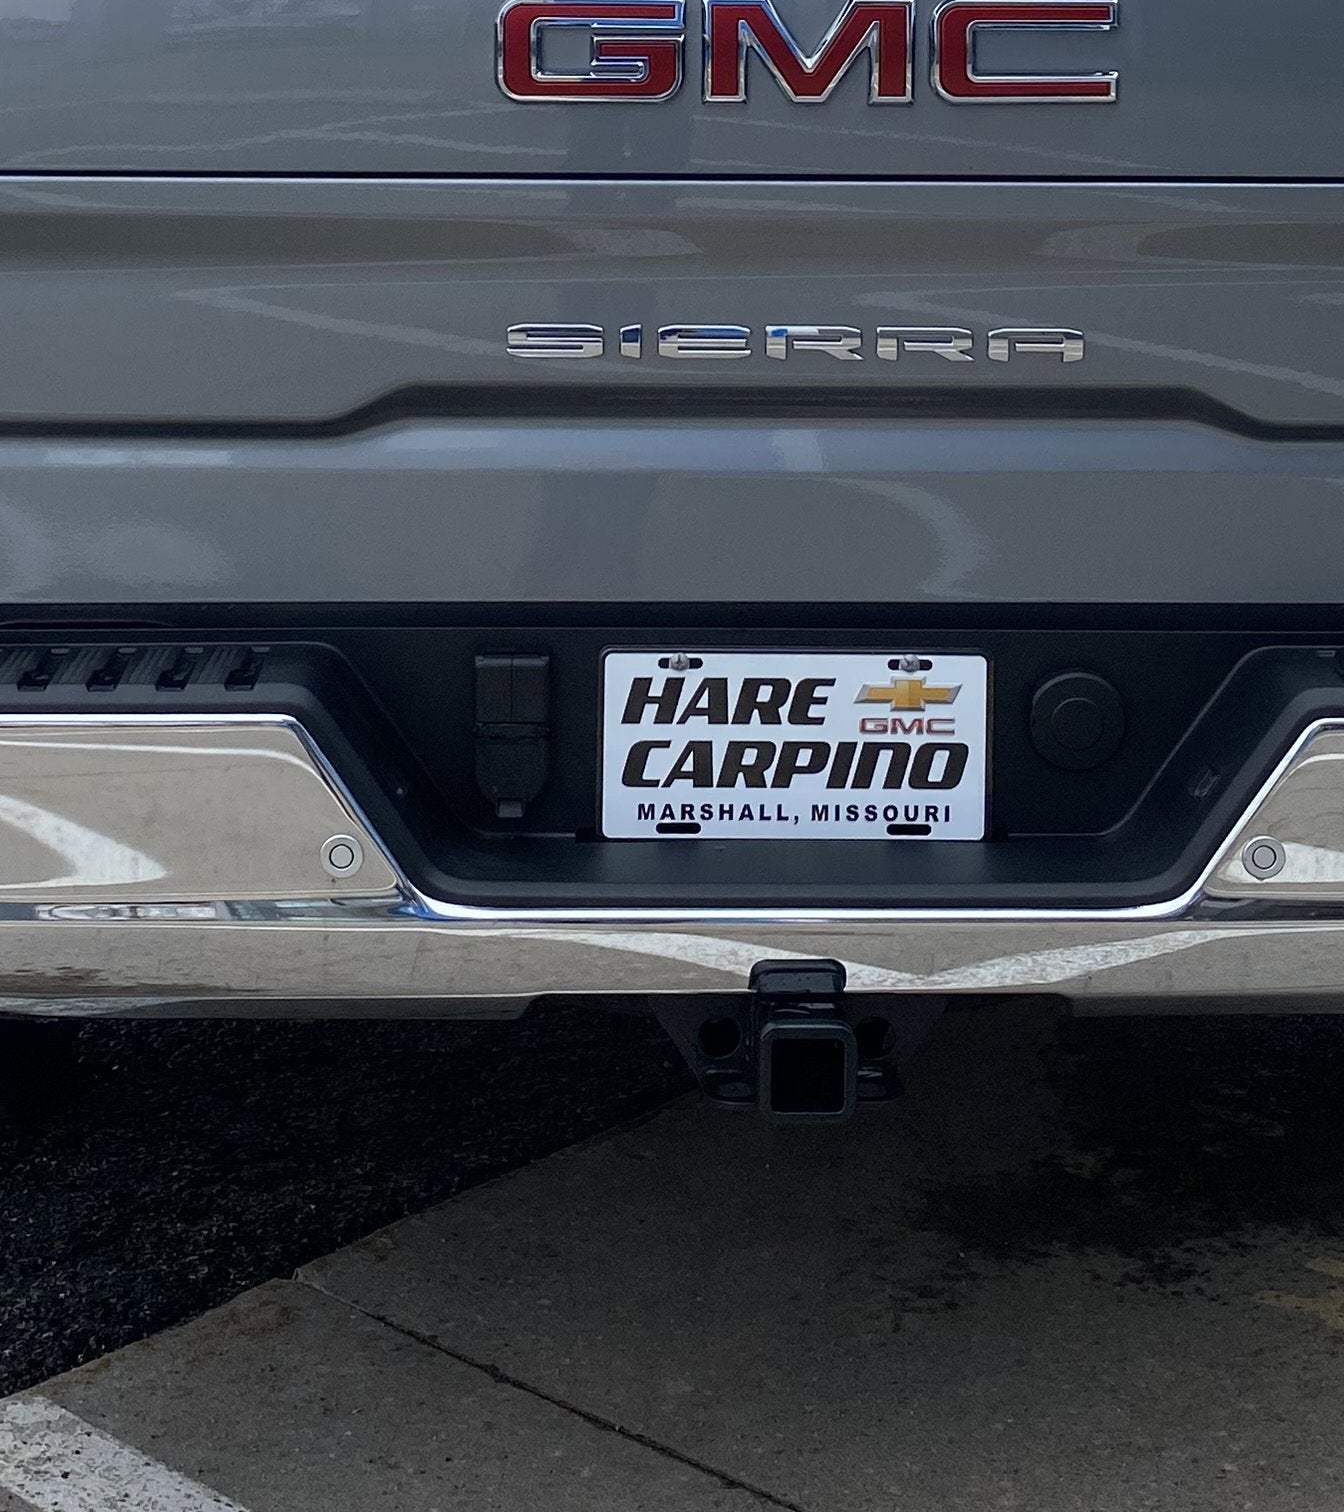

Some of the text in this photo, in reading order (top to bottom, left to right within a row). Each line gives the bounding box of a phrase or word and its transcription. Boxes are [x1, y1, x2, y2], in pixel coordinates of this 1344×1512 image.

[506, 322, 1085, 364] SIERRA
[621, 677, 837, 725] HARE
[859, 717, 957, 736] GMC
[621, 740, 969, 790] CARPINO
[637, 803, 951, 825] MARSHALL, MISSOURI
